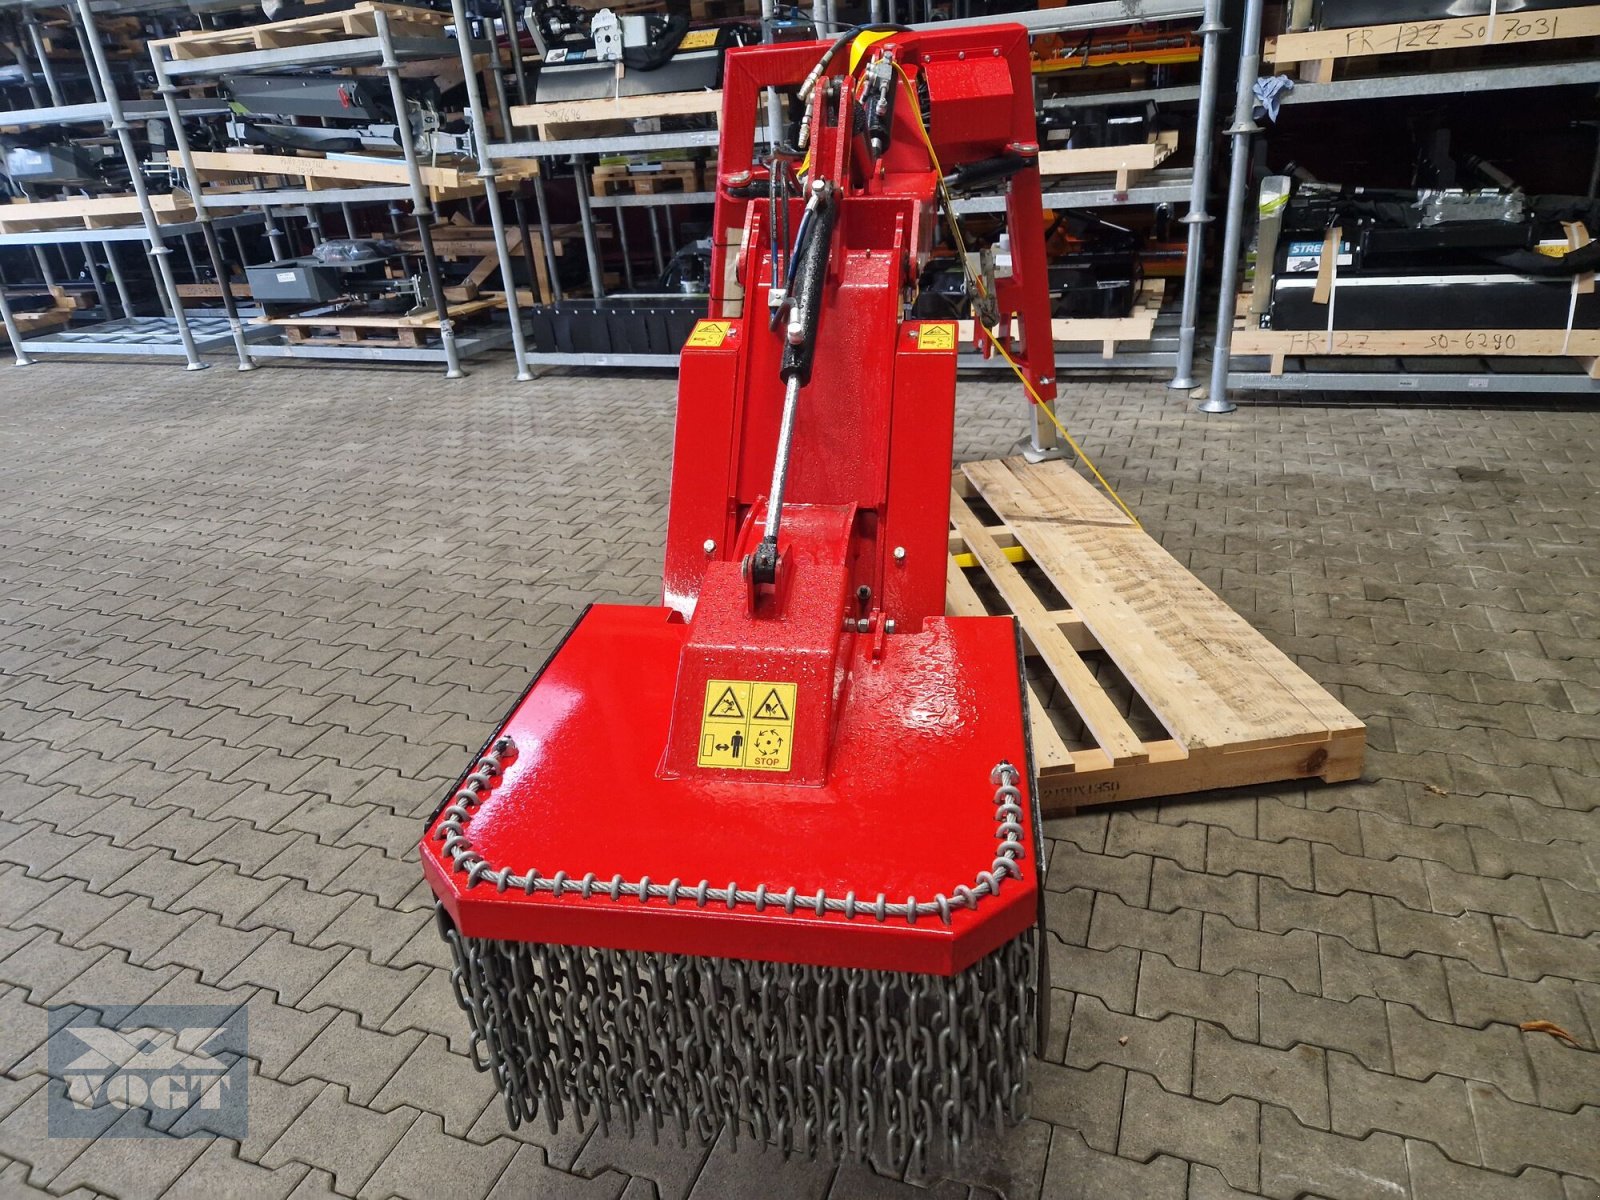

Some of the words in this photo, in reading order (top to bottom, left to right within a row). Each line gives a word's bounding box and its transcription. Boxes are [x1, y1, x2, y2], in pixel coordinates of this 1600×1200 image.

[1346, 29, 1374, 55] FR
[1502, 16, 1558, 41] 7031
[1291, 244, 1325, 254] STRE
[754, 757, 780, 766] STOP
